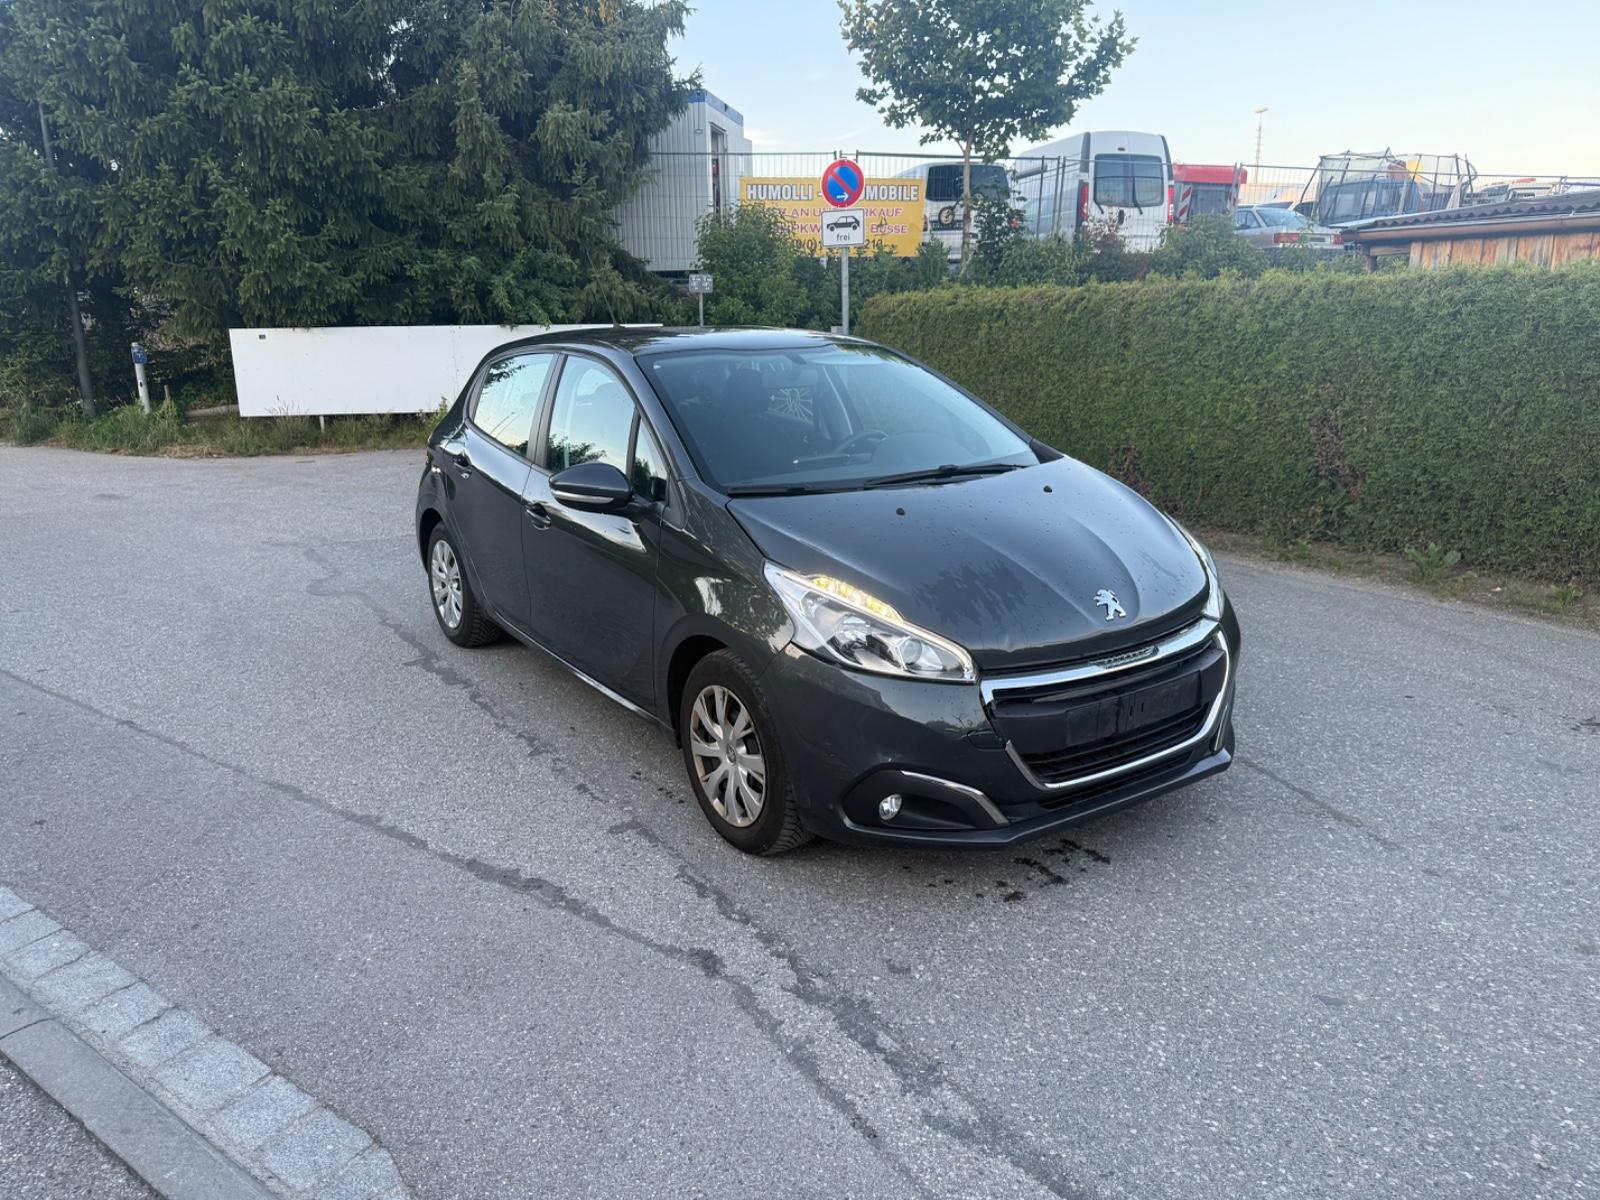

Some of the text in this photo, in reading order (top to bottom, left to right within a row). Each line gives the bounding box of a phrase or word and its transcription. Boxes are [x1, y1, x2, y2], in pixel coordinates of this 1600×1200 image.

[746, 183, 814, 201] HUMOLLI
[860, 183, 920, 201] MOBILE
[791, 208, 809, 217] AN
[863, 207, 903, 217] RKAUF
[836, 233, 851, 241] frei
